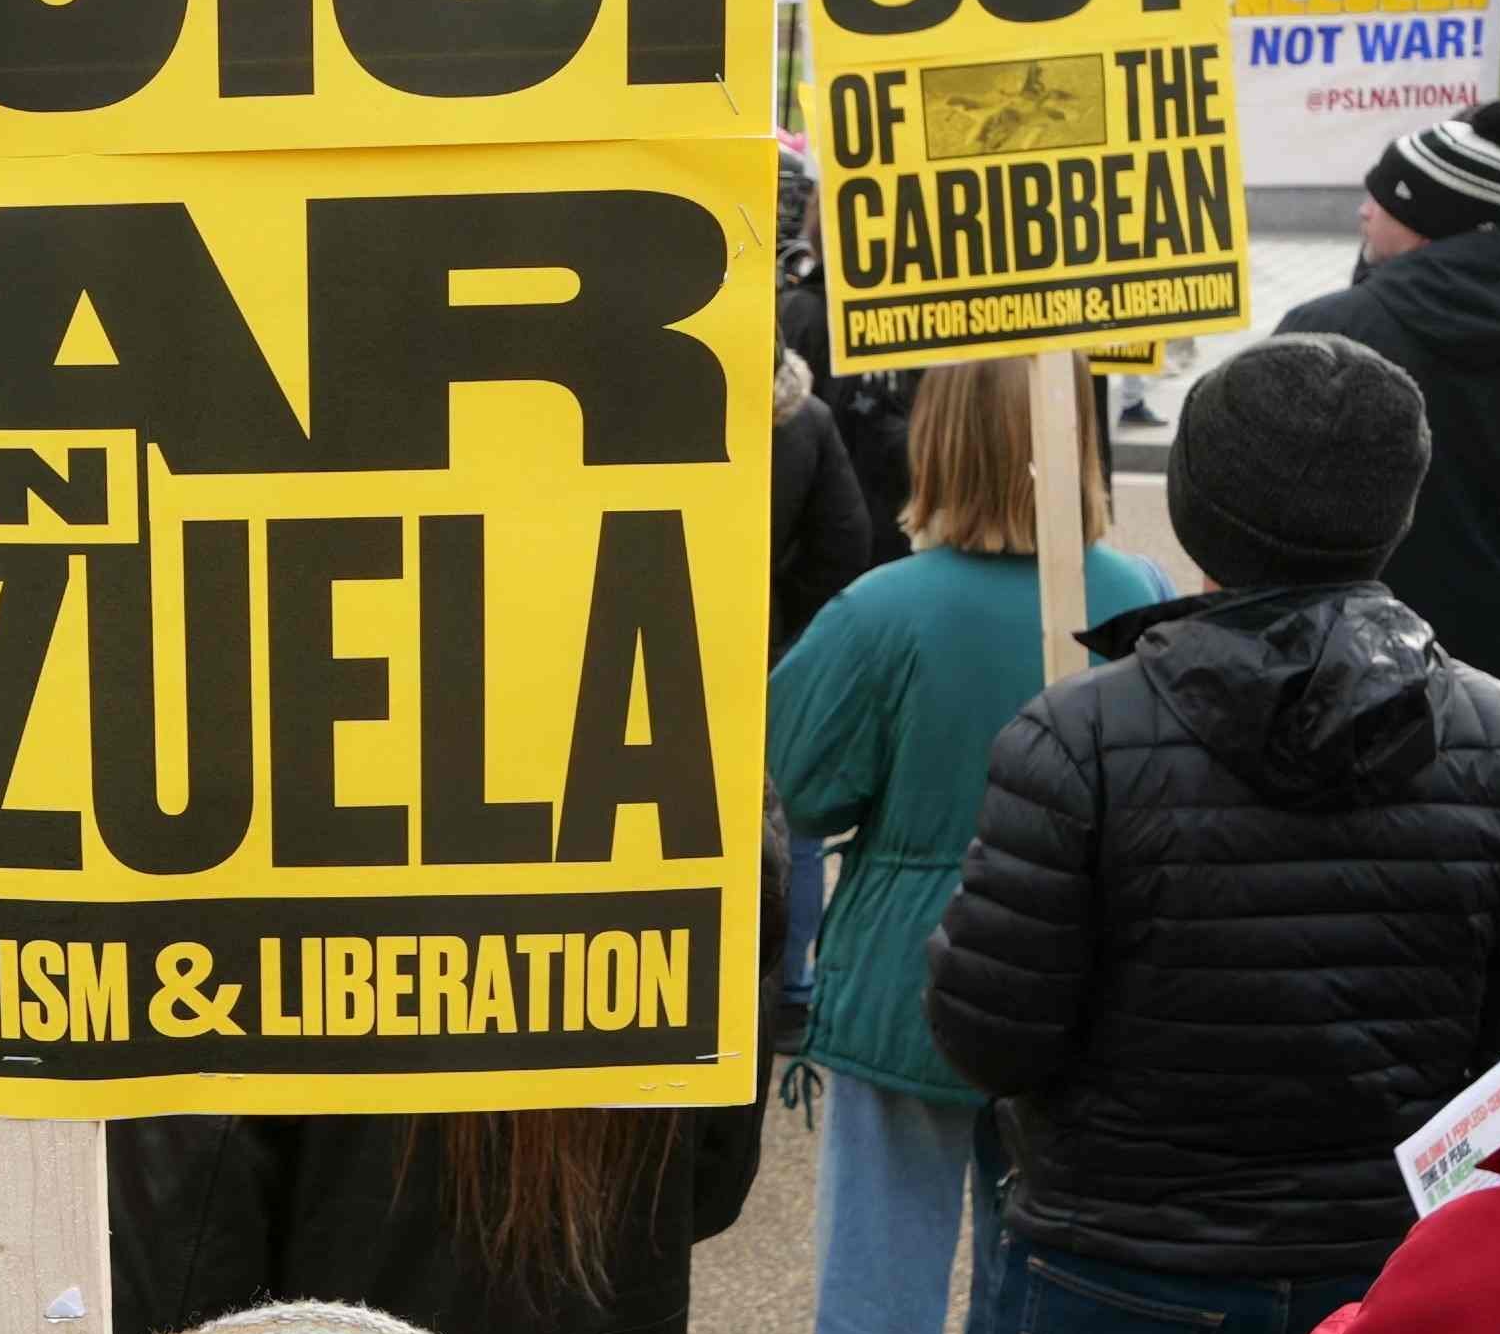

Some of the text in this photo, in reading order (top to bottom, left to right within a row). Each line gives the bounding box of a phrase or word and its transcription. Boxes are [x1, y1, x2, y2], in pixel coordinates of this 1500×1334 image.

[1250, 18, 1484, 66] NOT WAR!
[831, 46, 1224, 168] OF THE
[1306, 84, 1480, 110] @PSLNATIONAL
[838, 147, 1232, 288] CARIBBEAN
[849, 273, 1234, 347] PARTY FOR SOCIALISM & LIBERATION
[149, 942, 246, 1037] &
[260, 929, 689, 1035] LIBERATION
